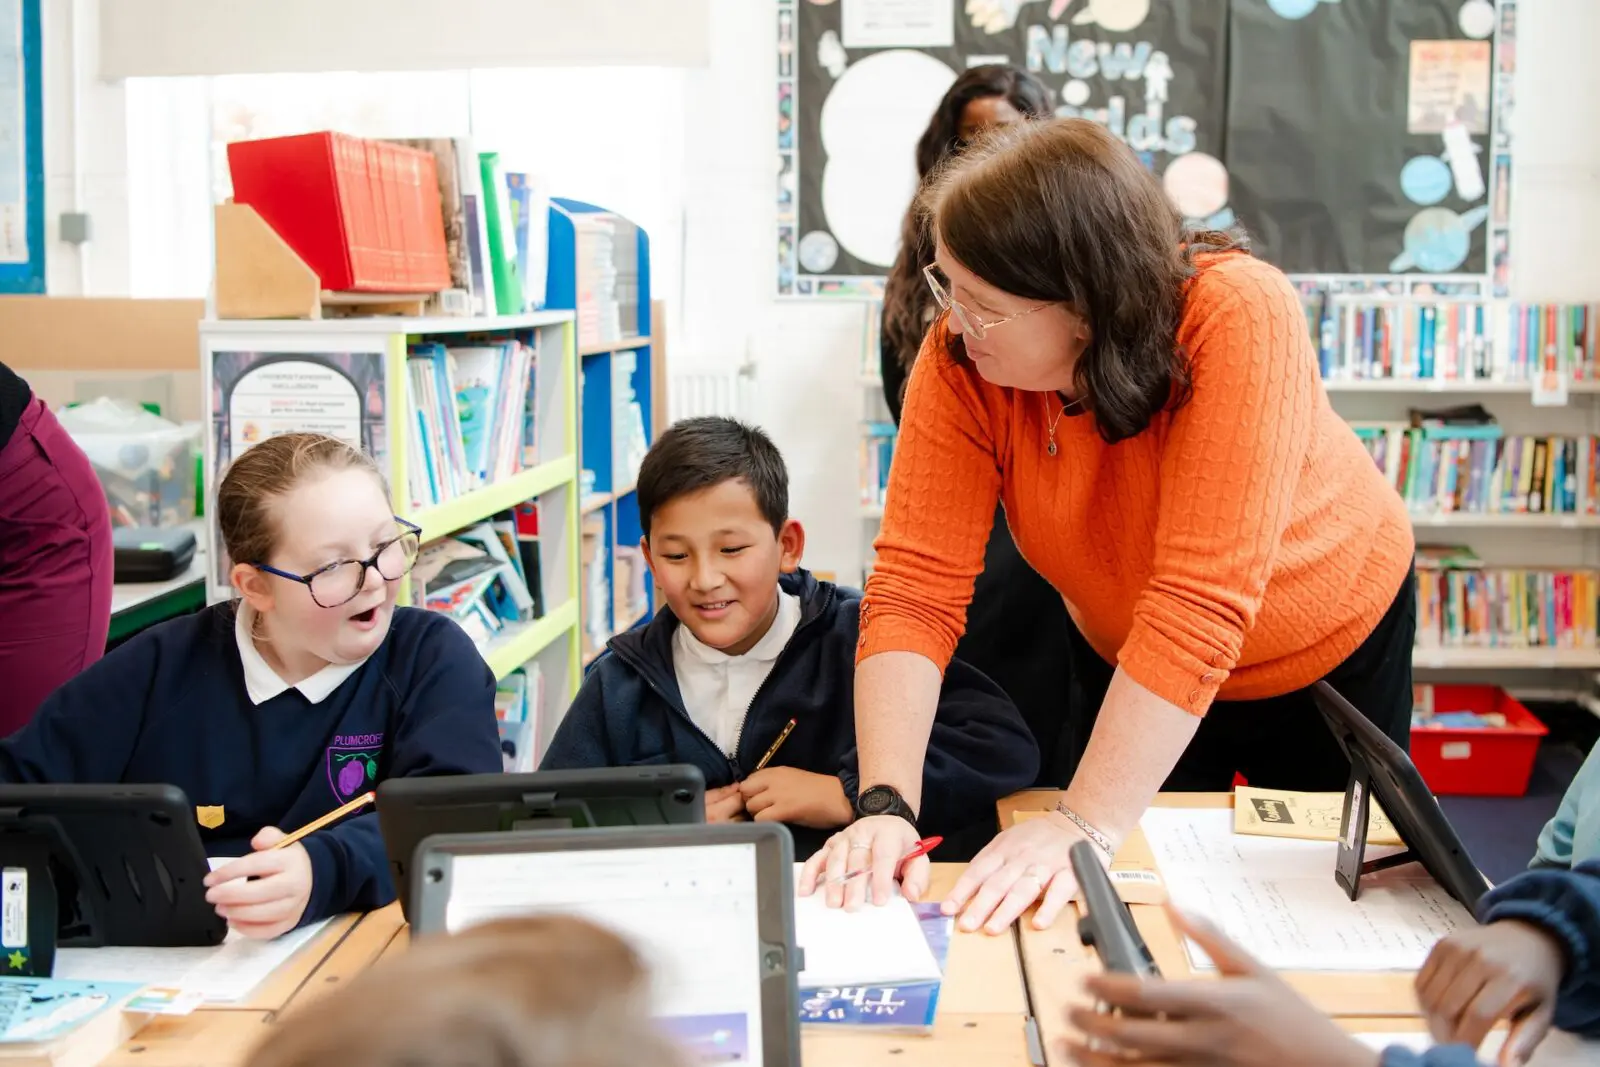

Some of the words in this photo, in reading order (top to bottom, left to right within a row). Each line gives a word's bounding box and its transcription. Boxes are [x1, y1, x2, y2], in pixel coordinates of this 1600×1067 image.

[1027, 24, 1152, 80] New
[1053, 92, 1198, 154] lds
[815, 987, 907, 1007] The
